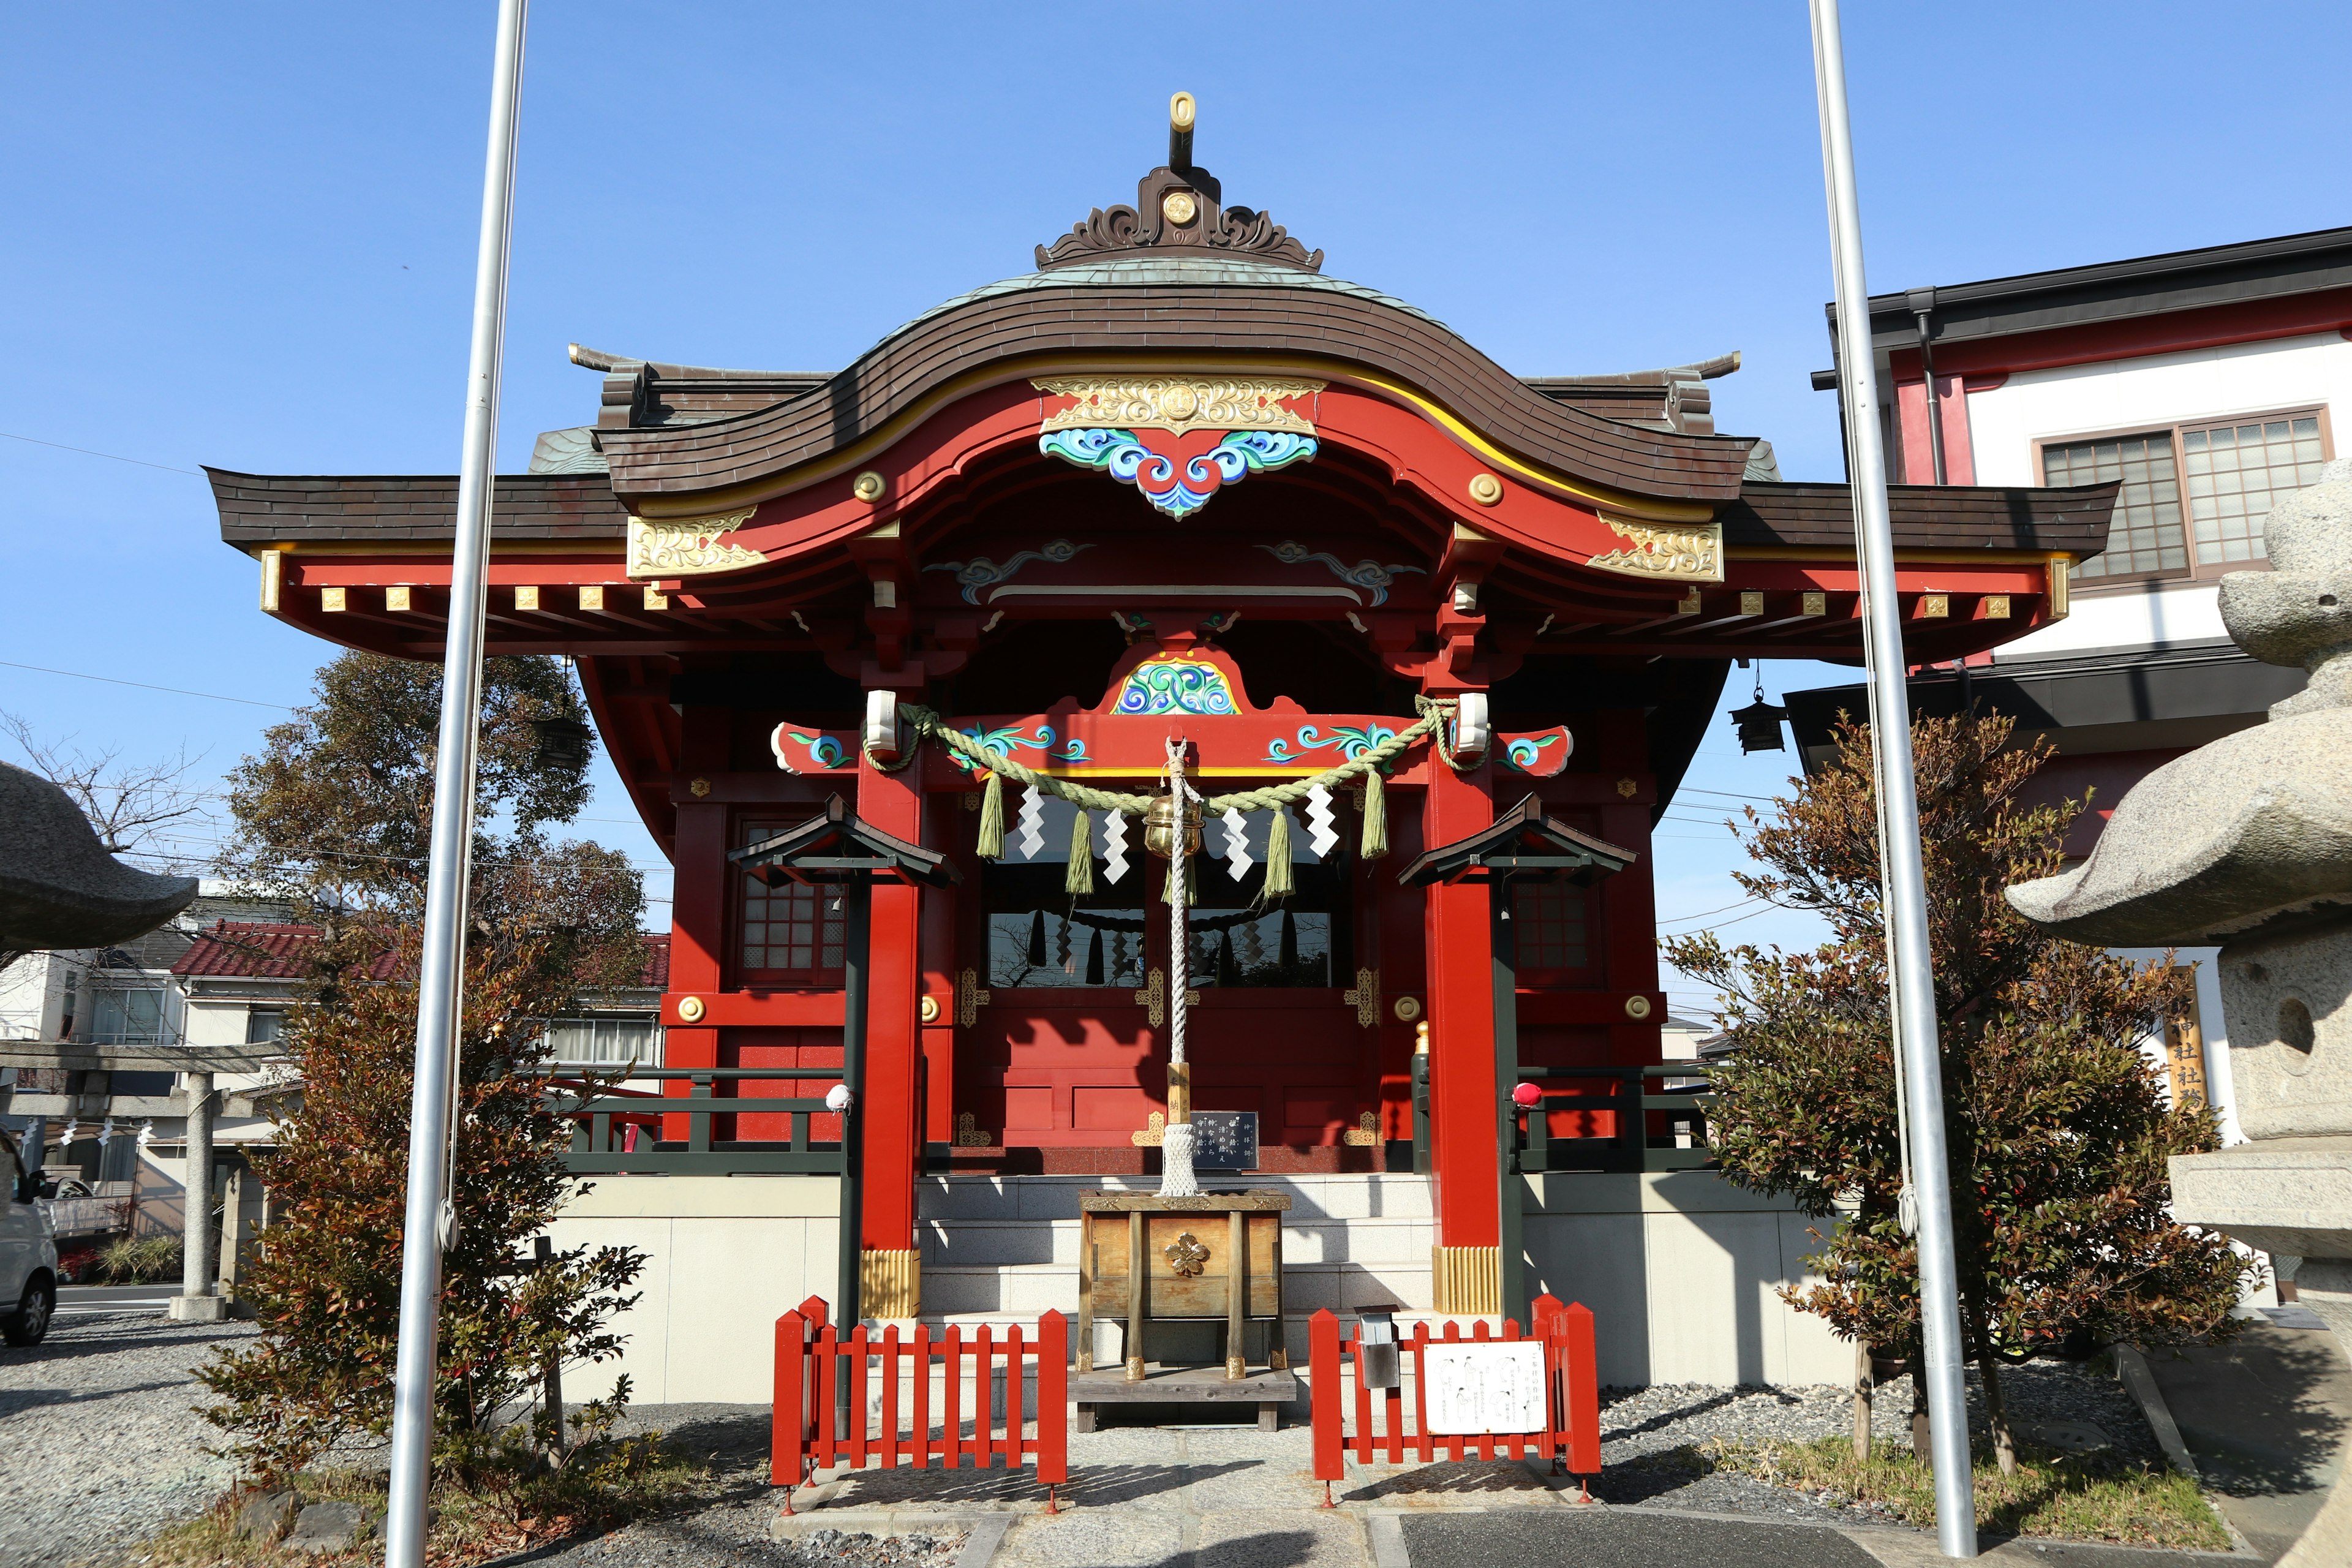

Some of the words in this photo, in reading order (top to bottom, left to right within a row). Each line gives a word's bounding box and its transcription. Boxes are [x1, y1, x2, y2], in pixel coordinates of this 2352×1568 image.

[2168, 970, 2203, 1108] 訪神社社務
[1170, 1077, 1178, 1110] 奉納
